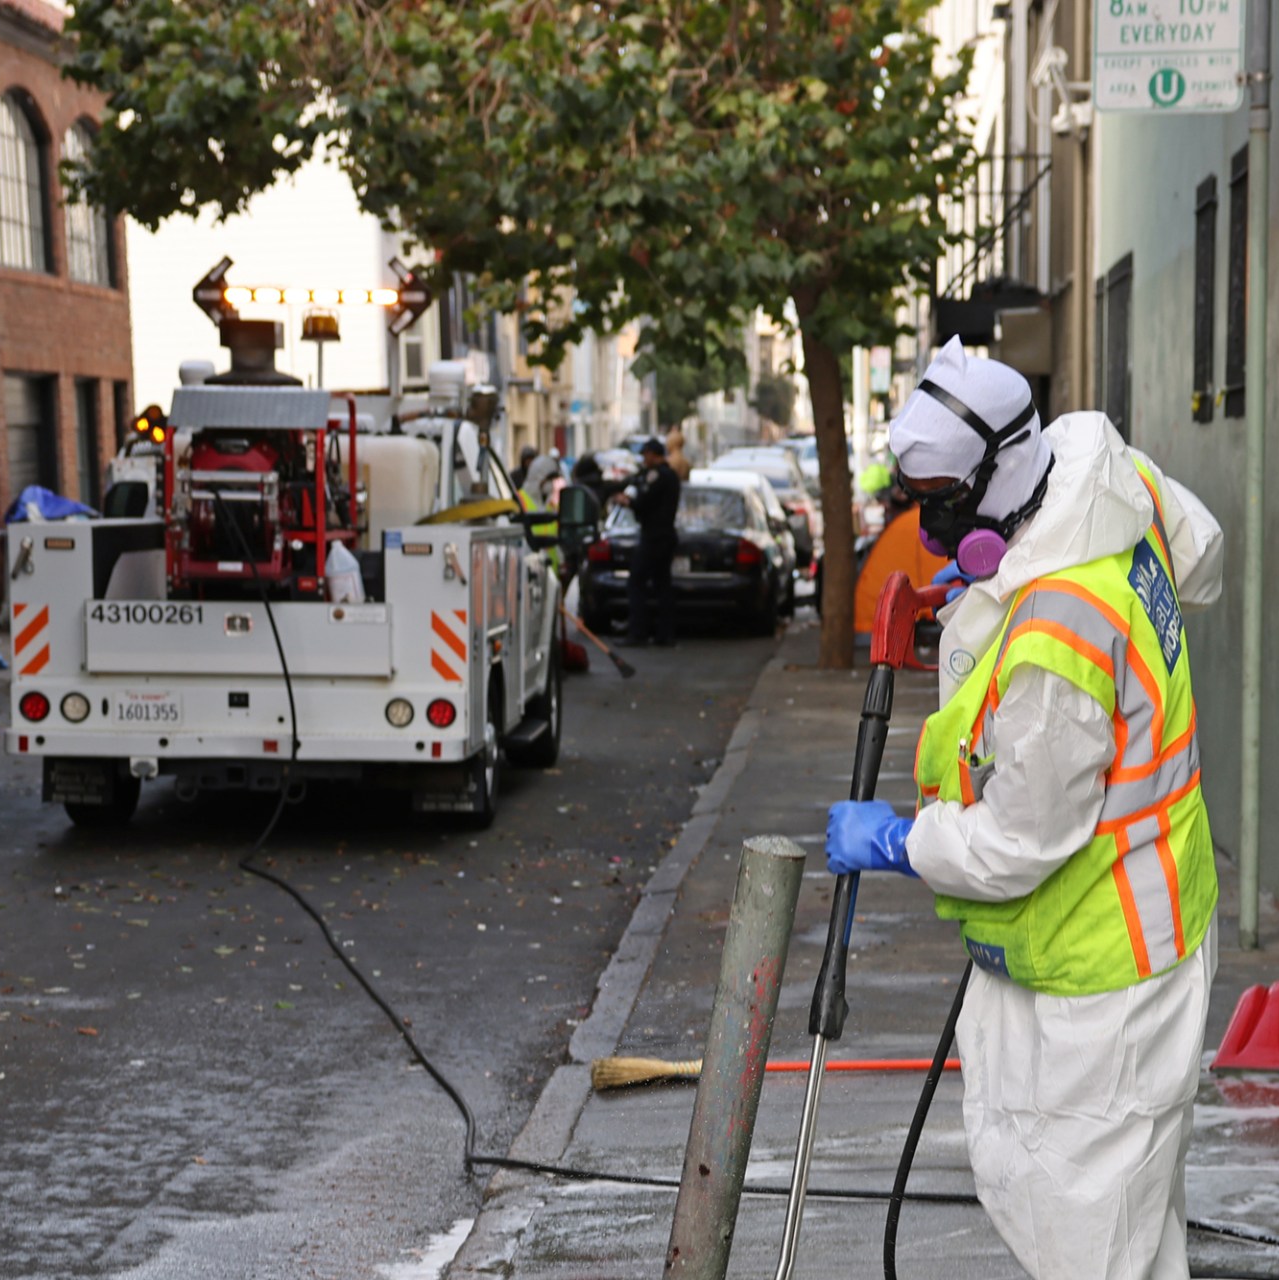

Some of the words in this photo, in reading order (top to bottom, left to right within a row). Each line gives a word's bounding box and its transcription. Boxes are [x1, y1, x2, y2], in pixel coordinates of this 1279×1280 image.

[1120, 22, 1216, 45] EVERYDAY
[1155, 71, 1179, 103] U
[91, 604, 203, 624] 43100261
[118, 703, 178, 721] 1601355
